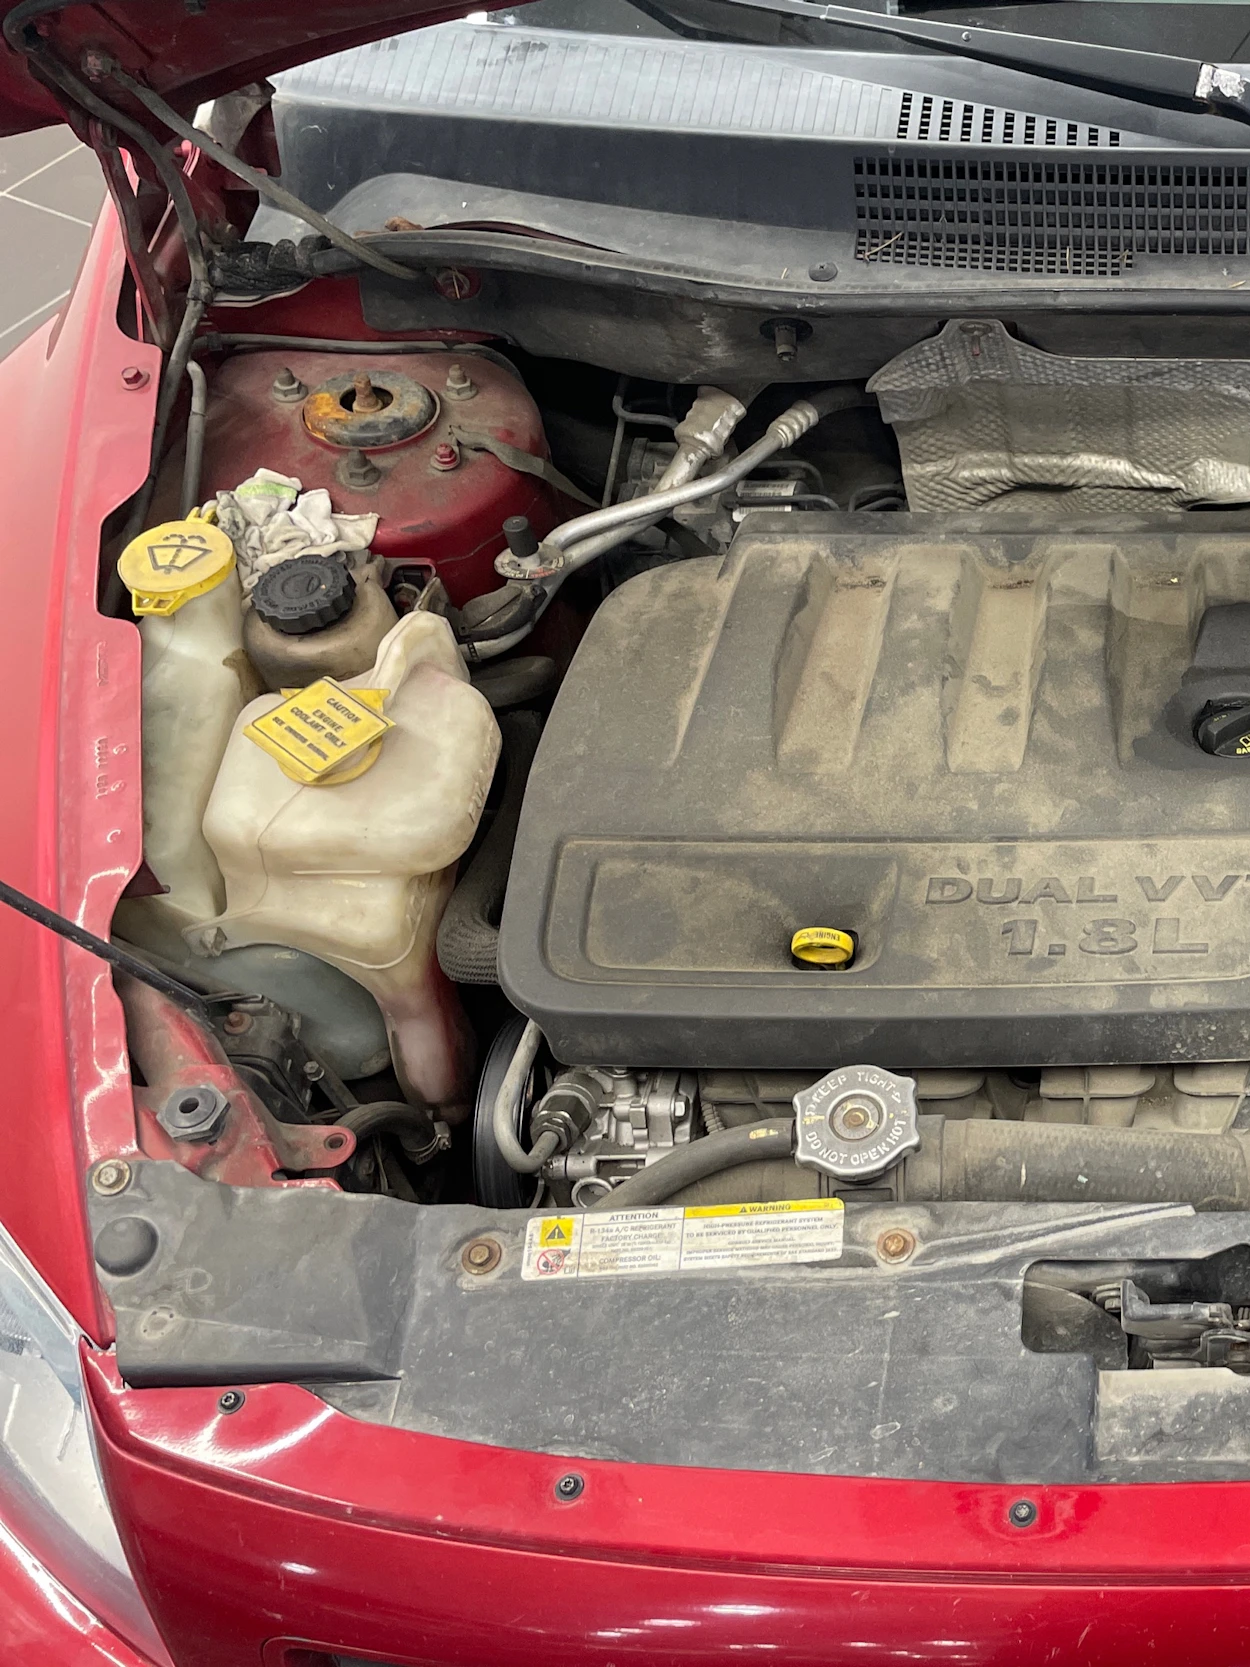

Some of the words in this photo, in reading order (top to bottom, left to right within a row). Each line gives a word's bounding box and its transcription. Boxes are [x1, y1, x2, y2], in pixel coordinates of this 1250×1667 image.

[312, 709, 344, 733] ENGINE
[326, 697, 362, 723] CAUTION
[290, 706, 327, 733] COOLANT
[324, 731, 347, 748] ONLY
[925, 876, 1118, 905] DUAL
[1001, 917, 1209, 956] 1.8L
[811, 1074, 847, 1104] KEEP
[857, 1071, 897, 1092] TIGHT
[805, 1131, 822, 1150] DO
[819, 1148, 848, 1165] NOT
[850, 1142, 890, 1166] OPEN
[886, 1119, 907, 1145] HOT
[609, 1212, 659, 1222] ATTENTION
[749, 1203, 792, 1213] WARNING
[615, 1225, 629, 1234] A/C
[630, 1223, 677, 1232] REFRIGERANT
[599, 1256, 647, 1265] COMPRESSOR
